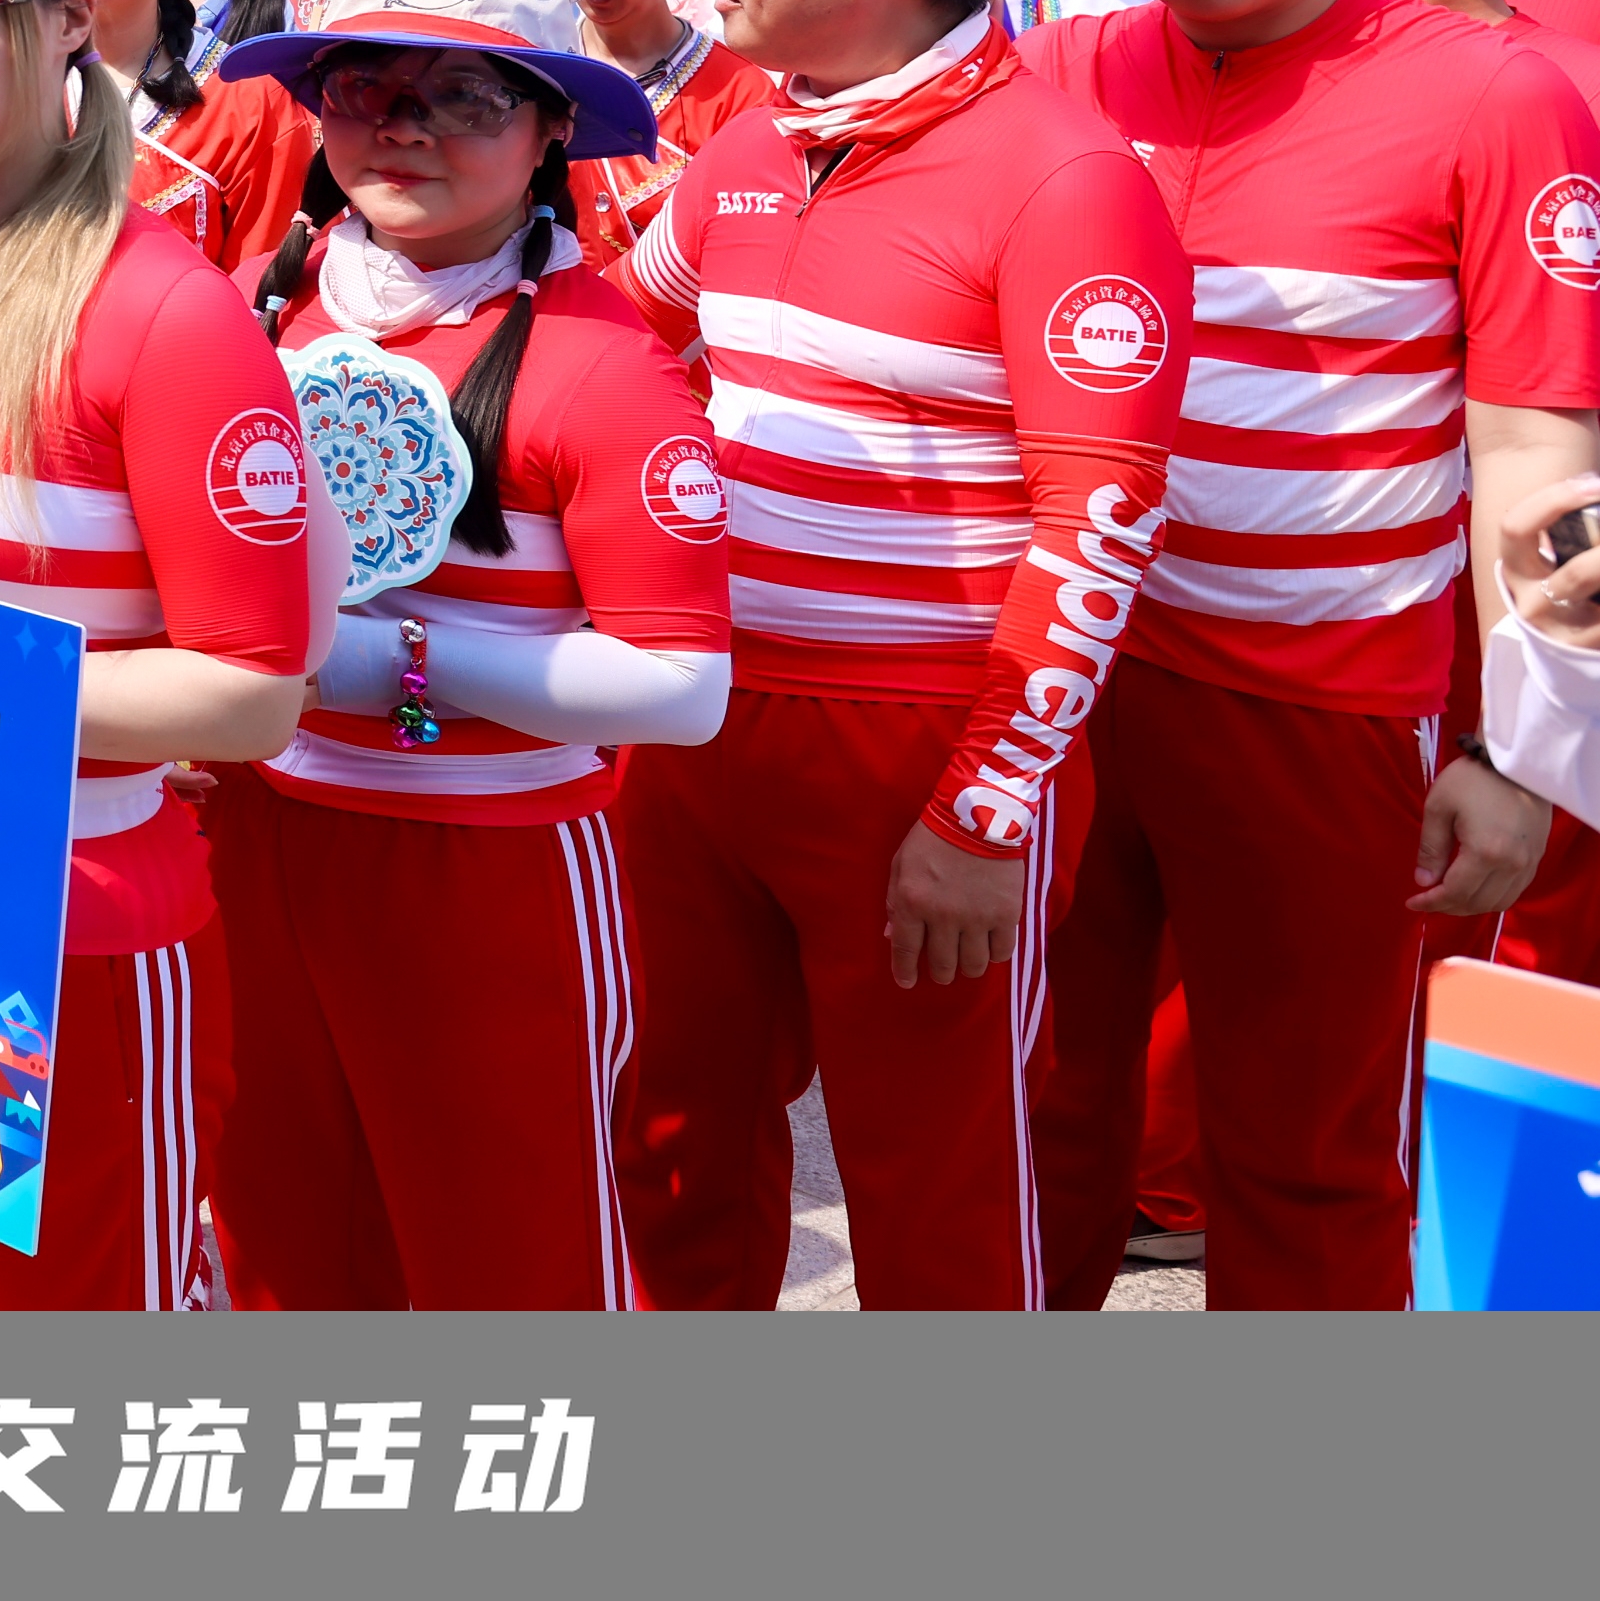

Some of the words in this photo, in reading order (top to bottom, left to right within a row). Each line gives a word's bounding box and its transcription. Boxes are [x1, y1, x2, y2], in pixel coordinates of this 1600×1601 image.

[716, 191, 784, 215] BATIE
[1081, 327, 1137, 343] BATIE
[245, 471, 295, 487] BATIE
[675, 483, 717, 496] BATIE
[953, 482, 1167, 848] Supreme
